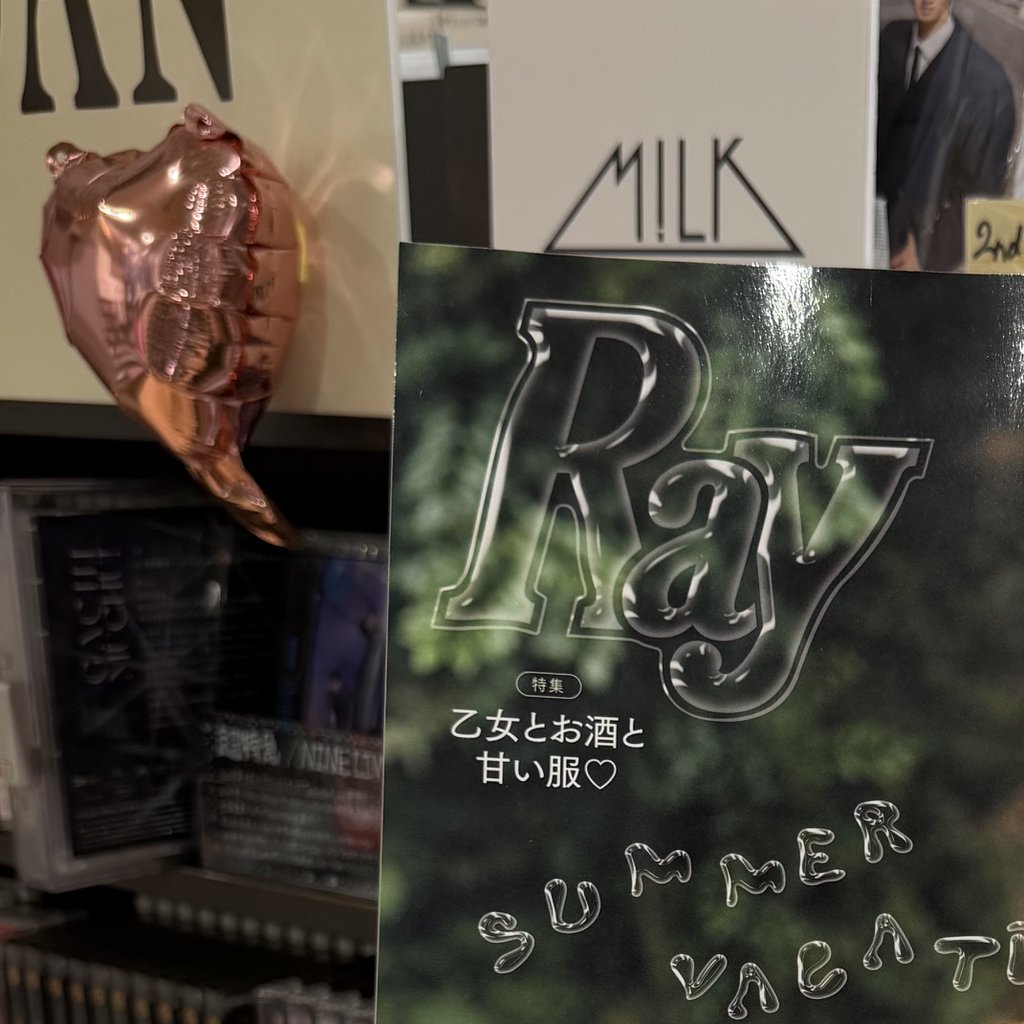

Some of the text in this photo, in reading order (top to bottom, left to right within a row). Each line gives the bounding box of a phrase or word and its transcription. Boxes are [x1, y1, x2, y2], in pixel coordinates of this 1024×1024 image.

[431, 299, 934, 722] Ray
[531, 676, 565, 694] 特集
[450, 708, 646, 749] 乙女とお酒と
[475, 750, 582, 789] 甘い服
[478, 799, 914, 975] SUMMER
